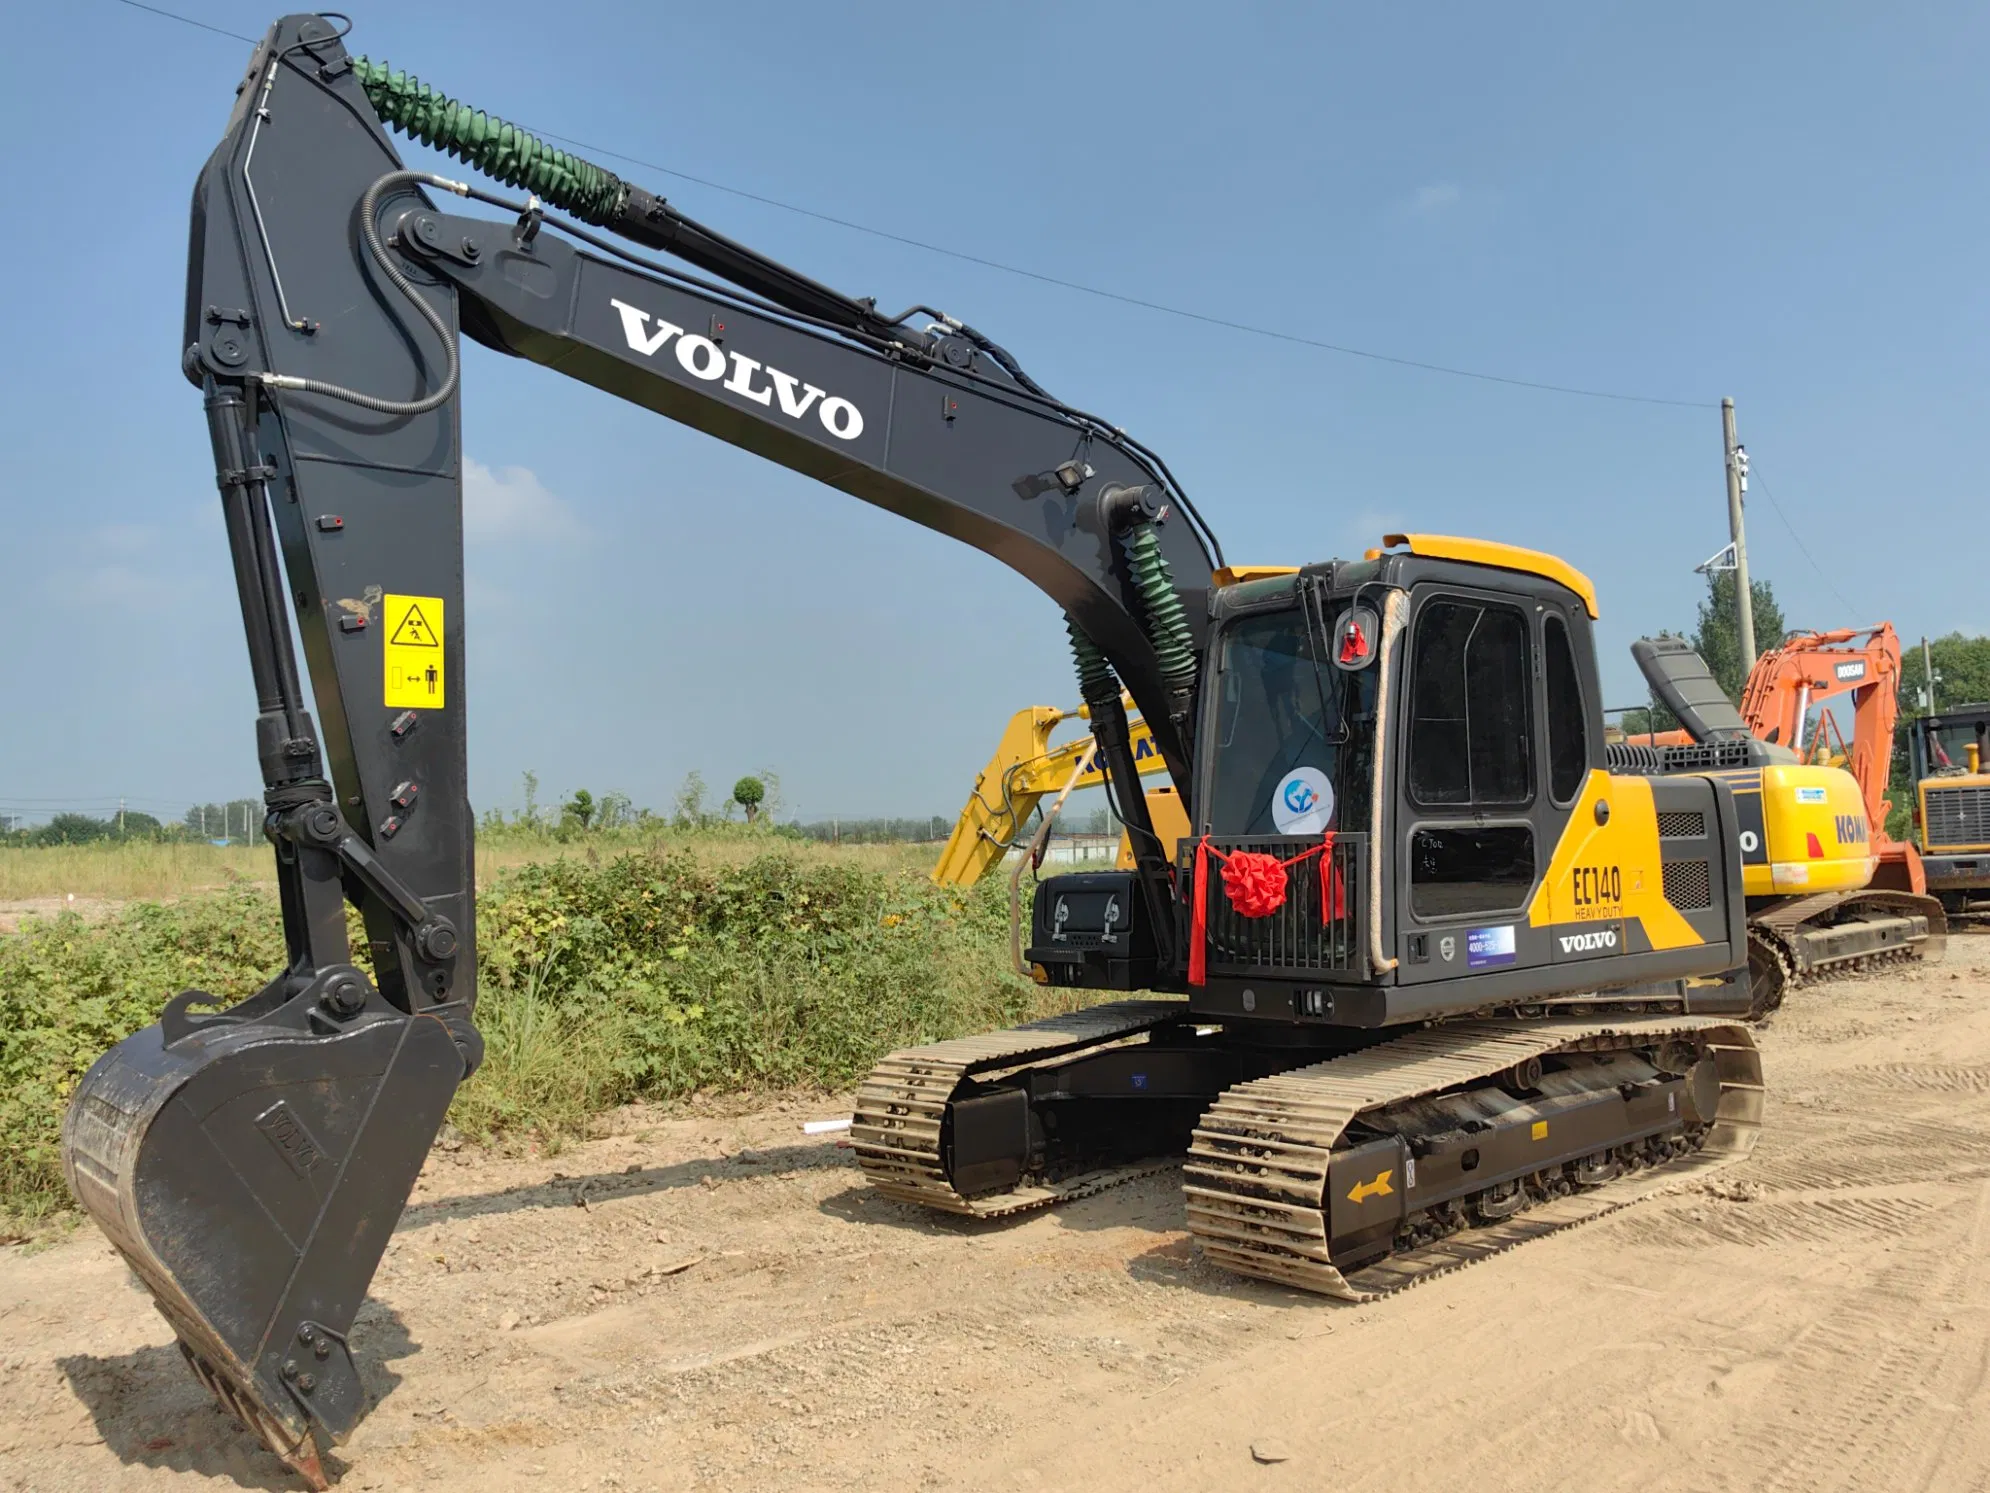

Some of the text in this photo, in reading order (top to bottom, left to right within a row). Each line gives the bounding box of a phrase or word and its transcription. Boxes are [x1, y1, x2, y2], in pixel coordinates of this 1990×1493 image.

[610, 298, 864, 440] VOLVO
[1572, 865, 1621, 906] EC140
[1559, 930, 1617, 953] VOLVO
